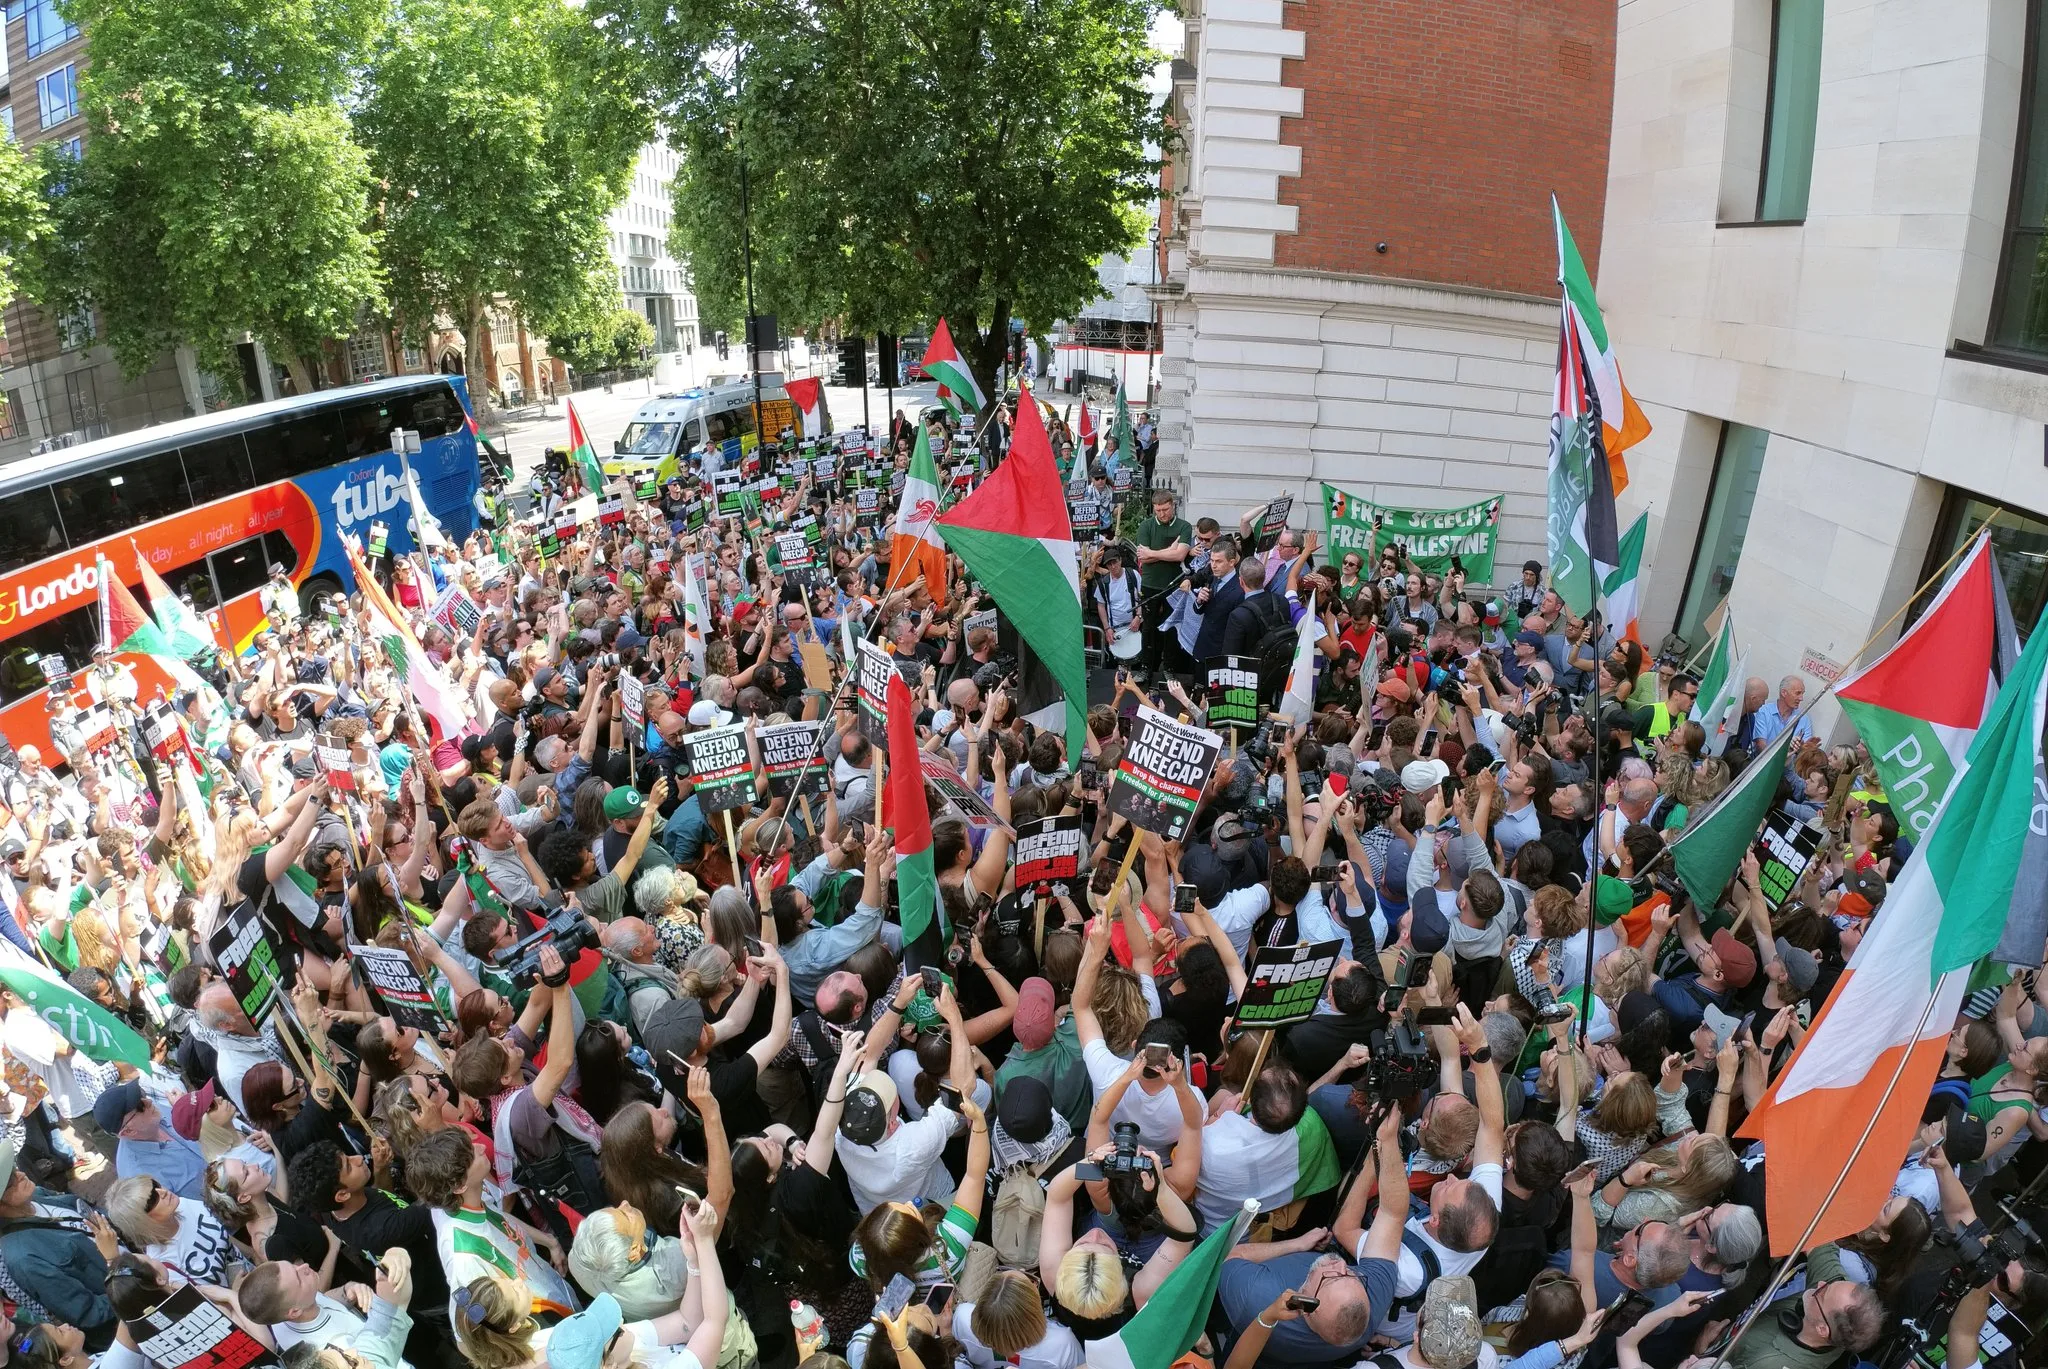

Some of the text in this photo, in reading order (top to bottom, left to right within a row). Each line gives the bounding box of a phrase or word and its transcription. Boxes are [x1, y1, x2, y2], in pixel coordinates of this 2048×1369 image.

[727, 395, 756, 407] POLIC
[74, 403, 107, 423] GROE
[843, 440, 866, 450] KNEECAP
[844, 433, 864, 443] DEFEND
[349, 466, 375, 484] Oxford
[1115, 472, 1131, 480] DEFEND
[332, 464, 420, 527] tube
[858, 493, 876, 502] DEFEND
[1073, 513, 1099, 522] KNEECAP
[1075, 506, 1097, 515] DEFEND
[1270, 501, 1290, 514] DEFEND
[1351, 499, 1482, 529] FREE SPEECH
[189, 531, 202, 549] all
[248, 512, 261, 528] all
[263, 505, 285, 525] year
[1330, 524, 1374, 550] FREE
[780, 539, 804, 551] DEFEND
[780, 548, 809, 560] KNEECAP
[864, 652, 889, 685] DEFE
[1804, 658, 1839, 679] GENOCIDE
[860, 669, 888, 704] KNEEC
[1208, 704, 1257, 721] CHARA
[693, 728, 734, 741] Socialist Worker
[765, 725, 807, 736] Socialist Worker
[1150, 714, 1207, 743] Socialist Worker
[692, 734, 740, 758] DEFEND
[764, 732, 813, 751] DEFEND
[1140, 722, 1205, 765] DEFEND
[692, 749, 746, 774] KNEECAP
[763, 745, 820, 765] KNEECAP
[1127, 740, 1204, 786] KNEECAP
[698, 779, 720, 789] Freedom
[728, 774, 750, 785] Palestine
[702, 766, 743, 782] Drop the charges
[770, 770, 791, 778] Freedom
[1132, 766, 1186, 795] Drop the charges
[1121, 772, 1190, 809] Freedom for Palestine
[1017, 828, 1080, 854] DEFEND
[1016, 843, 1079, 866] KNEECAP
[1016, 866, 1077, 889] CHARGES
[1759, 871, 1787, 905] ARA
[362, 956, 410, 977] DEFEND
[368, 971, 421, 992] KNEECAP
[1238, 997, 1317, 1019] CHARA
[185, 1213, 221, 1276] CUT
[137, 1301, 223, 1360] DEFEND
[153, 1316, 233, 1369] KNEECAP
